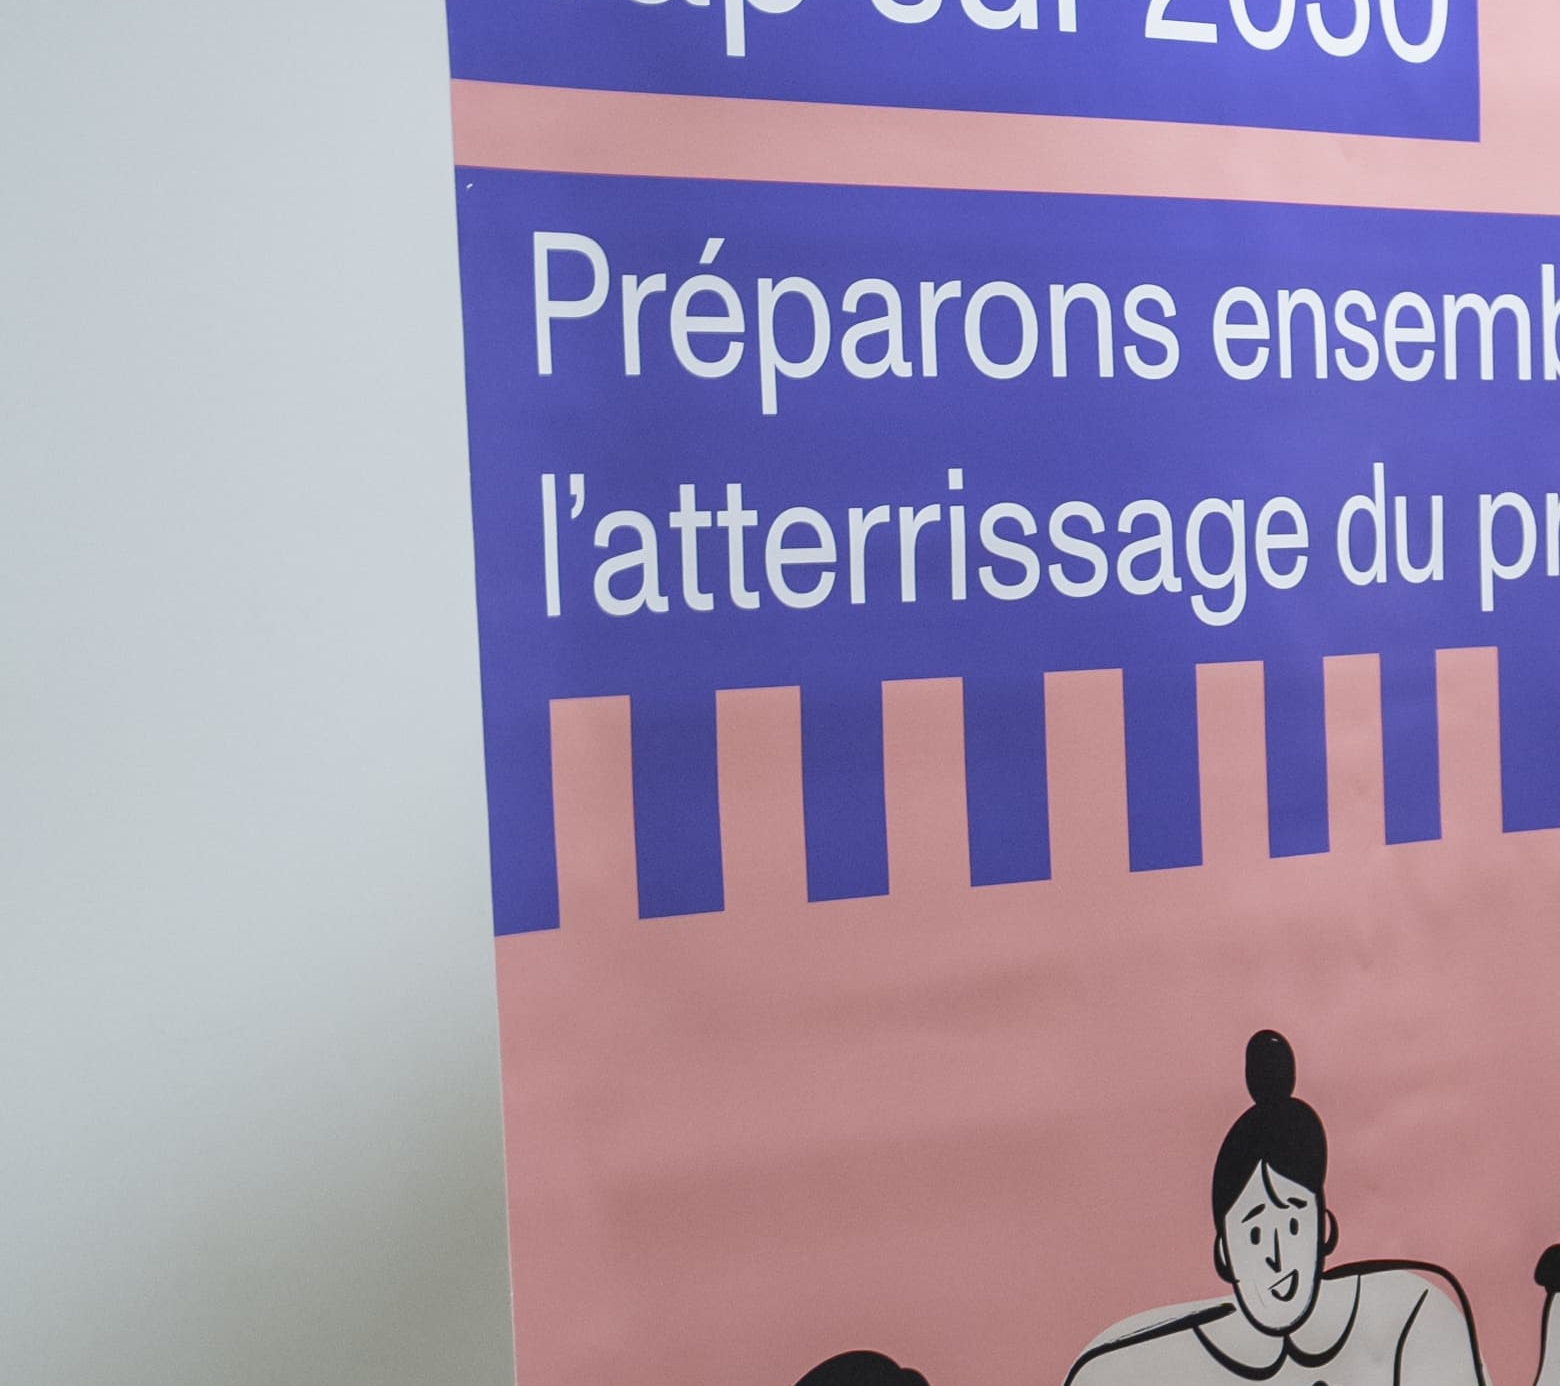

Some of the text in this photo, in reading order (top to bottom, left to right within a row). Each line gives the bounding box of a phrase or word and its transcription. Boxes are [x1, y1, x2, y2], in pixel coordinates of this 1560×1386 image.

[532, 230, 1181, 416] Préparons
[540, 468, 1310, 628] l’atterrissage
[1336, 462, 1445, 587] du
